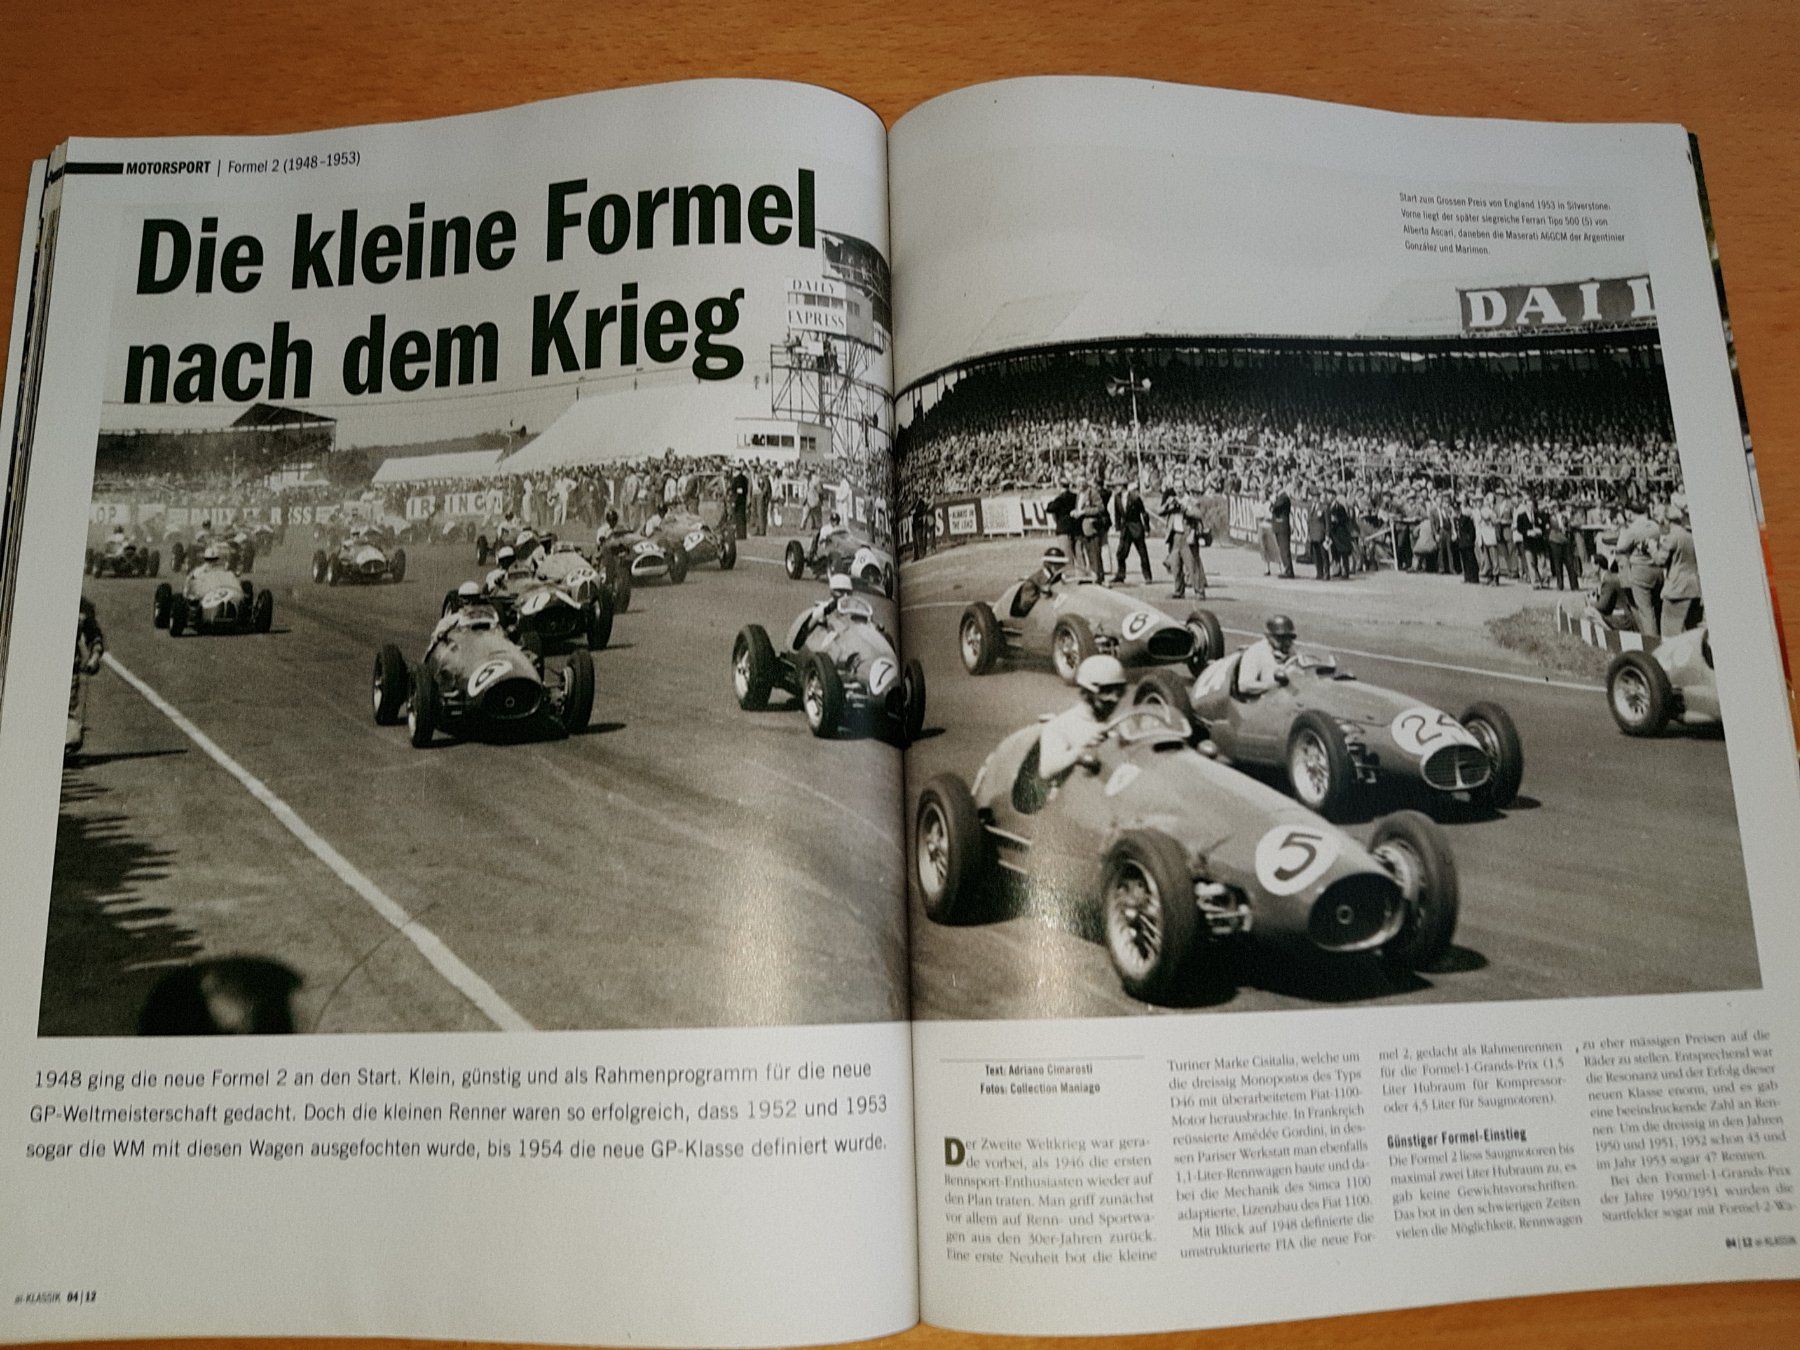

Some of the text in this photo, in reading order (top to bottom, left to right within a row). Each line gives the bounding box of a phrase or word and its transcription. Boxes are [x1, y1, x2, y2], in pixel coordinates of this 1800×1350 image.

[126, 161, 211, 174] MOTORSPORT
[228, 159, 268, 174] Formel
[271, 158, 280, 173] 2
[1399, 192, 1417, 202] Start
[1436, 196, 1466, 205] Grossen
[1467, 197, 1487, 206] Preis
[1488, 199, 1502, 207] von
[1503, 198, 1535, 210] England
[1537, 199, 1556, 209] 1953
[1557, 201, 1565, 209] in
[1566, 201, 1612, 210] Silverstone.
[1400, 209, 1421, 218] Vorne
[1422, 210, 1440, 221] liegt
[1441, 212, 1453, 220] der
[1455, 213, 1479, 224] später
[1481, 214, 1520, 225] siegreiche
[1521, 215, 1546, 224] Ferrari
[1548, 215, 1564, 227] Tipo
[1564, 215, 1580, 225] 500
[1581, 216, 1593, 226] (5)
[136, 169, 816, 295] Die kleine Formel
[1402, 224, 1429, 234] Alberto
[1457, 229, 1490, 238] daneben
[1492, 230, 1504, 238] die
[1505, 230, 1539, 239] Maserati
[1569, 232, 1581, 241] der
[1583, 233, 1625, 244] Argentinier
[1438, 243, 1454, 252] und
[791, 279, 836, 295] DAILY
[788, 310, 846, 329] EXPRESS
[123, 282, 745, 405] nach dem Krieg
[878, 660, 894, 687] 7
[1273, 831, 1323, 881] 5
[36, 1062, 872, 1091] 1948 ging die neue Formel 2 an den Start. Klein, günstig und als Rahmenprogramm für die neue
[985, 1063, 1093, 1075] Text: Adriano Cimarosti
[980, 1082, 1100, 1094] Fotos: Collection Maniago
[30, 1094, 887, 1123] GP-Weltmeisterschaft gedacht. Doch die kleinen Renner waren so erfolgreich, dass 1952 und 1953
[1386, 1127, 1527, 1149] Günstiger Formel-Einstieg
[26, 1136, 888, 1161] sogar die WM mit diesen Wagen ausgefochten wurde, bis 1954 die neue GP-Klasse definiert wurde.
